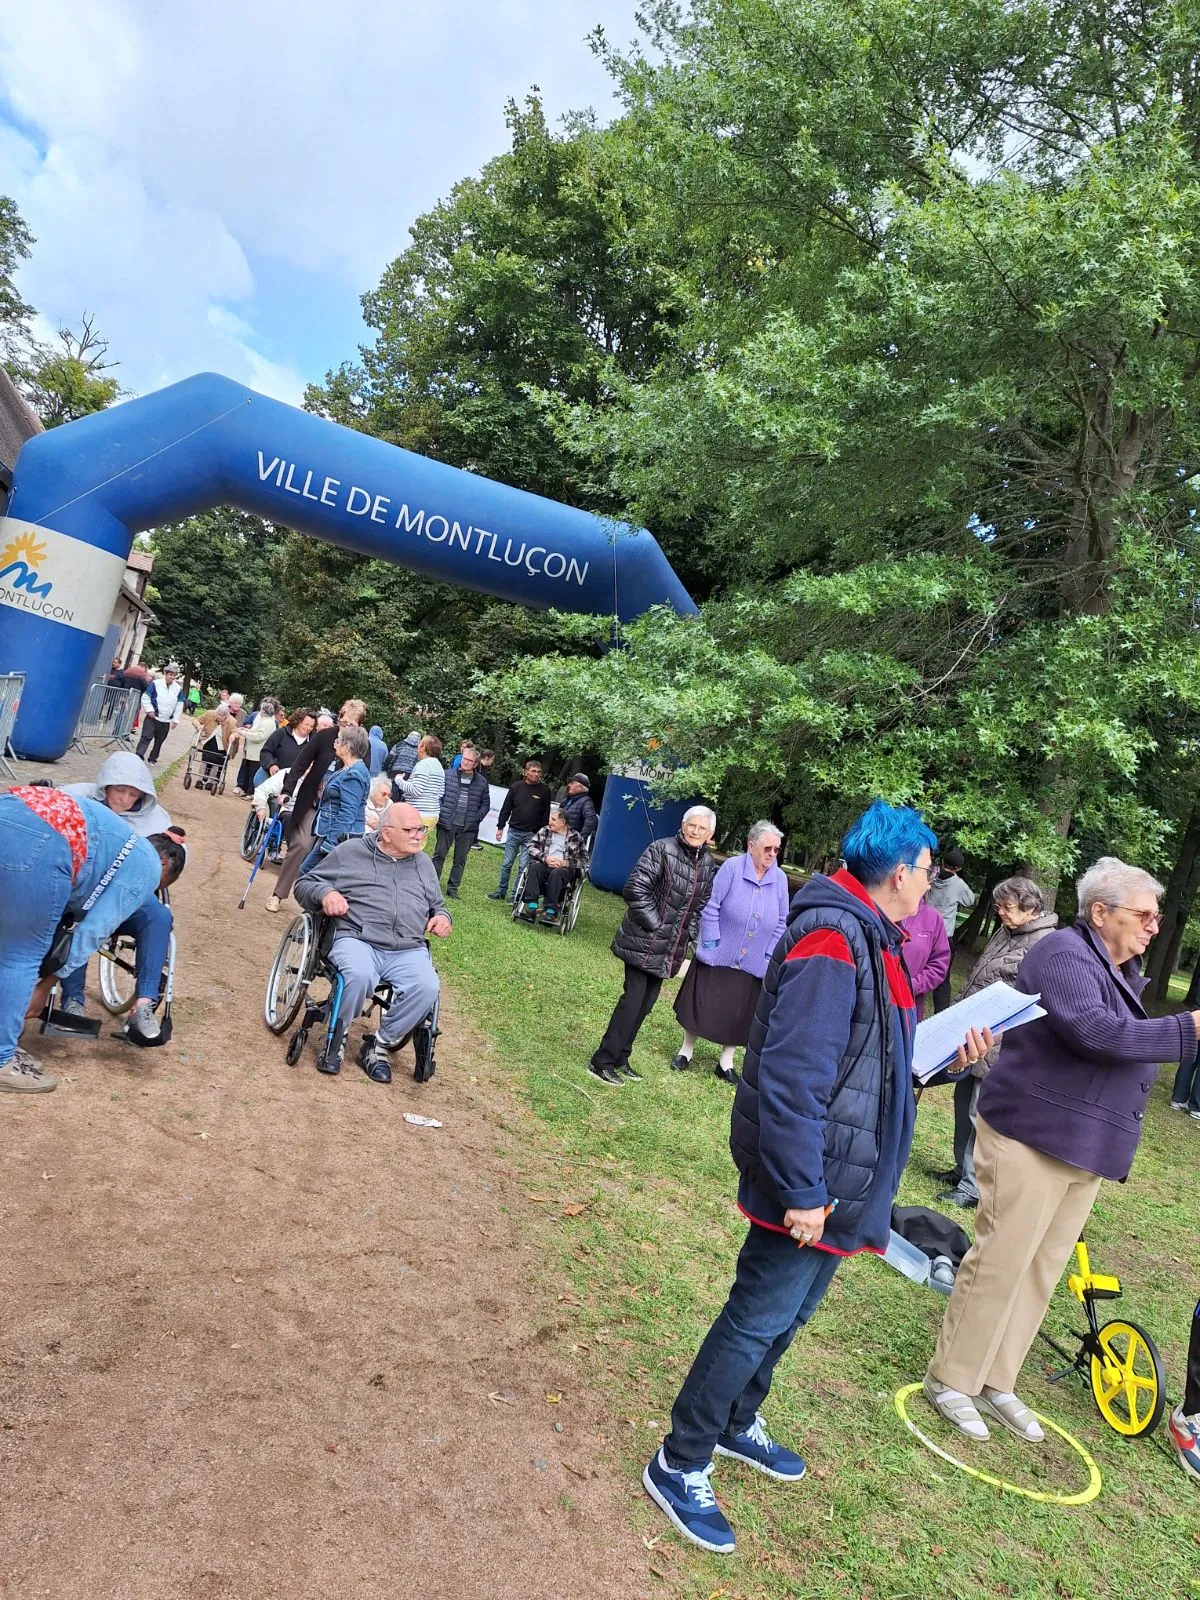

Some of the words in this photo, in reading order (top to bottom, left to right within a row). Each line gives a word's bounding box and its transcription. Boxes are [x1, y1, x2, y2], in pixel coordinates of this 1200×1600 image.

[257, 450, 341, 507] VILLE
[346, 486, 391, 524] DE
[395, 503, 590, 586] MONTLUÇON
[0, 587, 74, 622] ONTLUÇON
